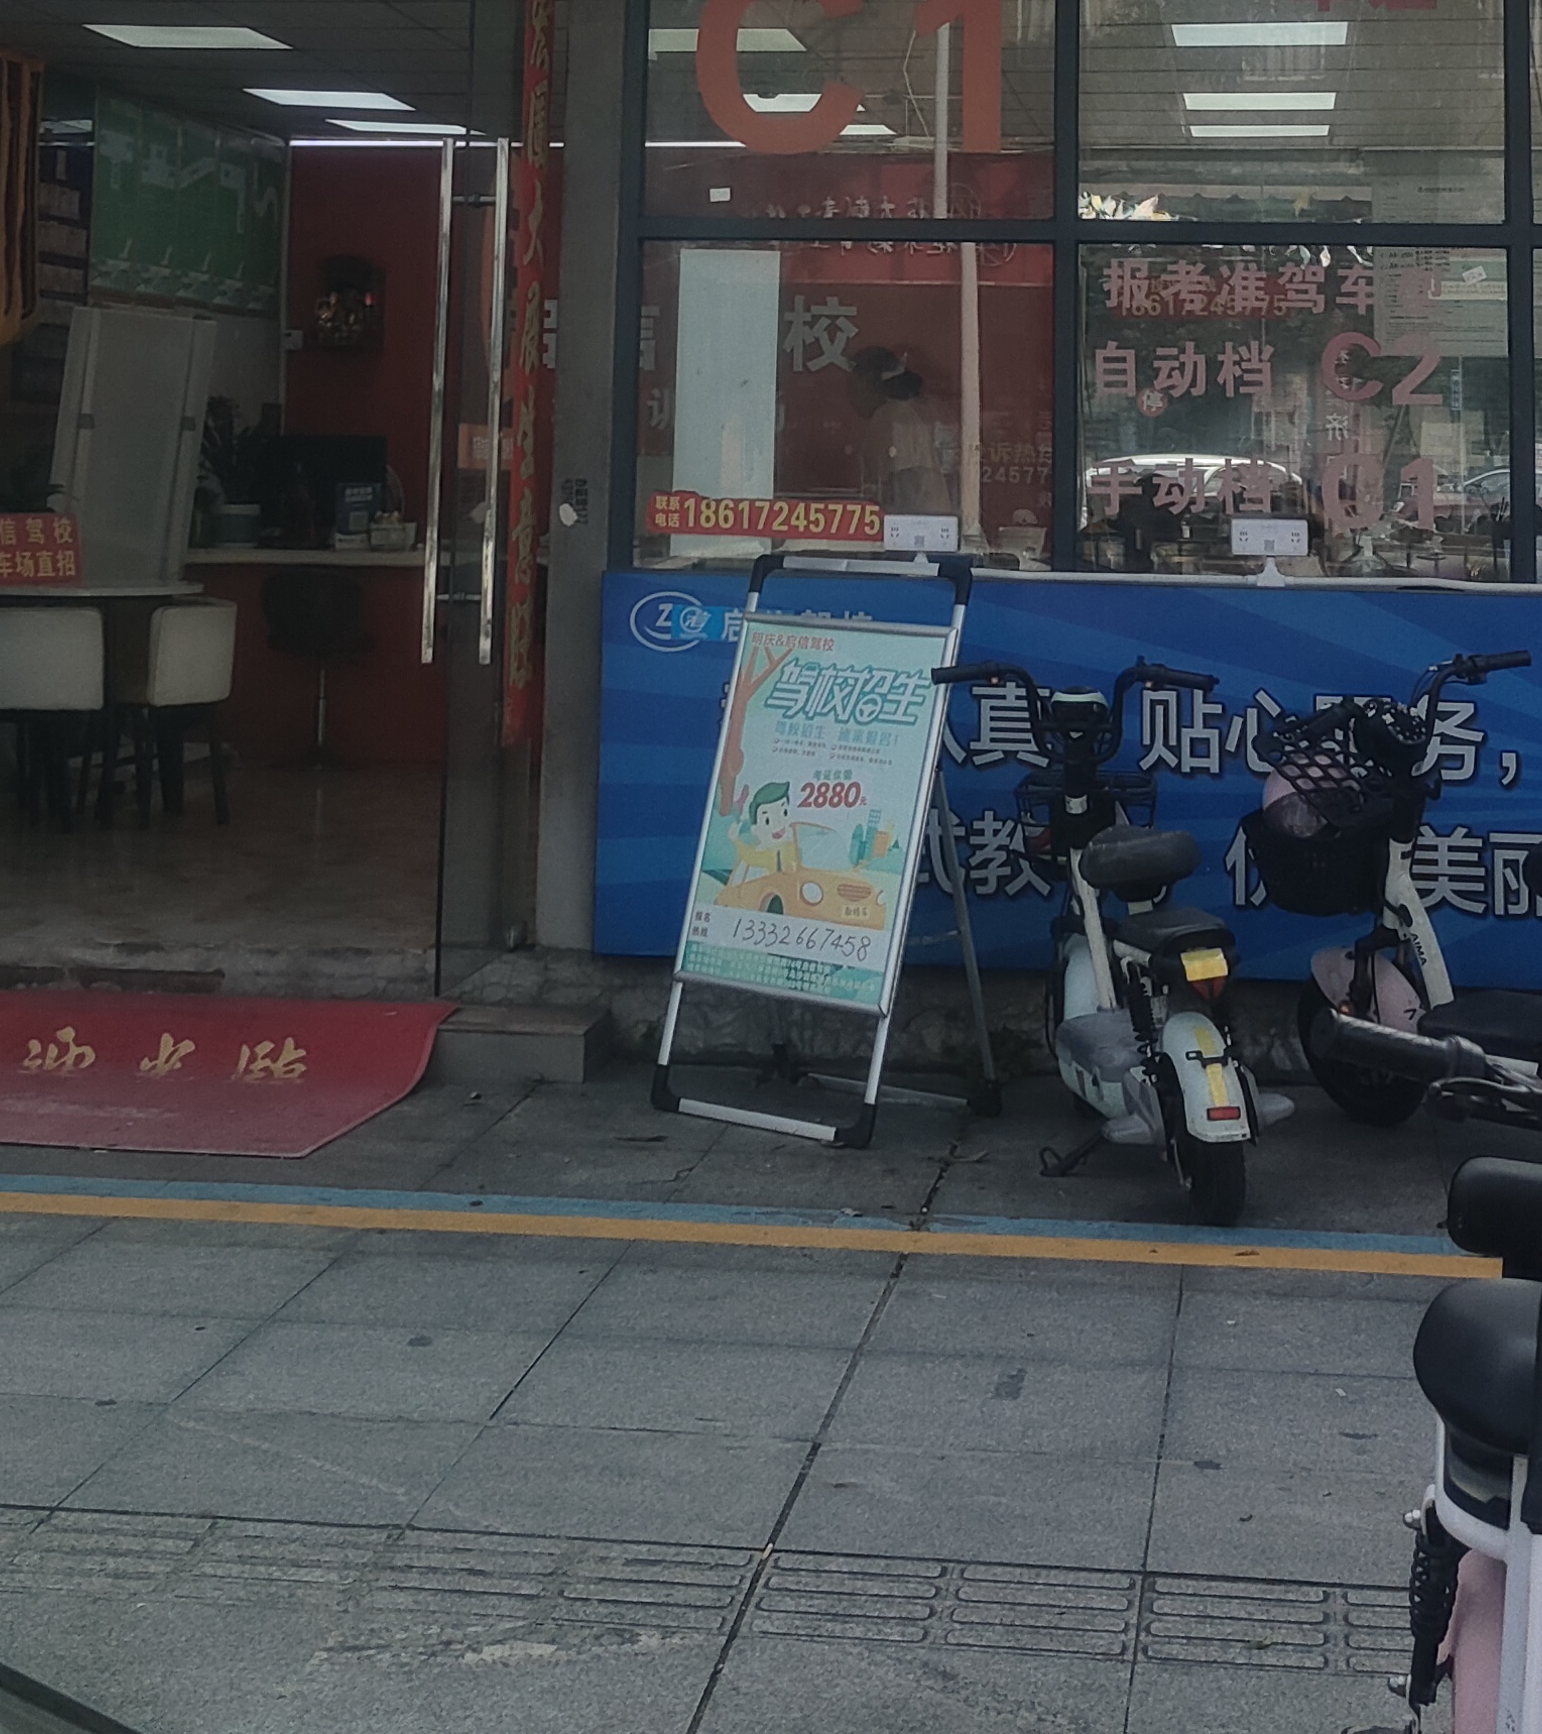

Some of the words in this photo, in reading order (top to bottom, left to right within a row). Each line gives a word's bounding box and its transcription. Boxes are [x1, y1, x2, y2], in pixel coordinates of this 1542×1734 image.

[1094, 340, 1275, 398] 自动档
[1322, 332, 1443, 405] C2
[655, 496, 681, 512] 联系
[1088, 458, 1275, 517] 手动档
[654, 512, 680, 529] 电话
[683, 496, 882, 536] 18617245775
[732, 918, 871, 962] 13332667458
